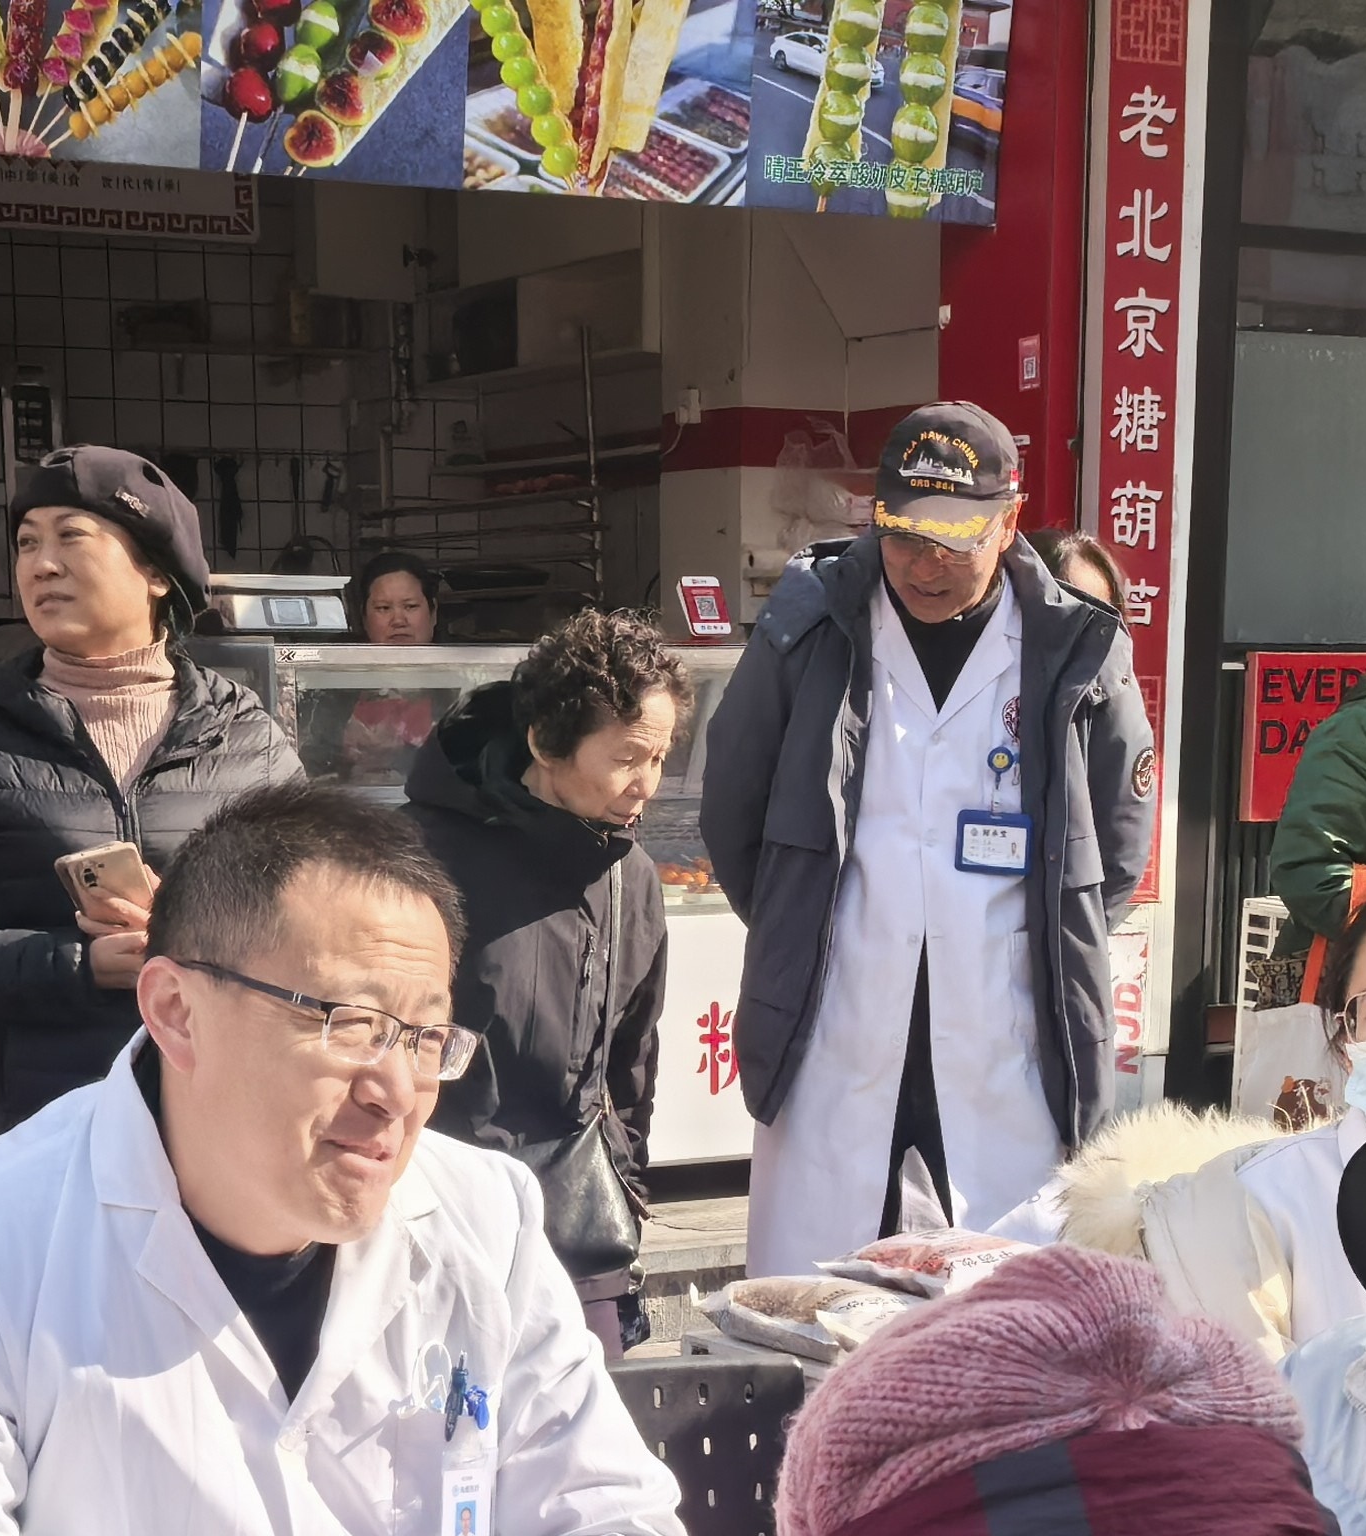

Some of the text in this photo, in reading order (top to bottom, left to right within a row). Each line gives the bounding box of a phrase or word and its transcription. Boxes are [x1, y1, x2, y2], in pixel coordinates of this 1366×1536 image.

[1109, 85, 1178, 628] 老北京糖葫芦
[920, 430, 950, 444] NAVY
[952, 438, 980, 469] CHINA
[1259, 718, 1325, 755] DA
